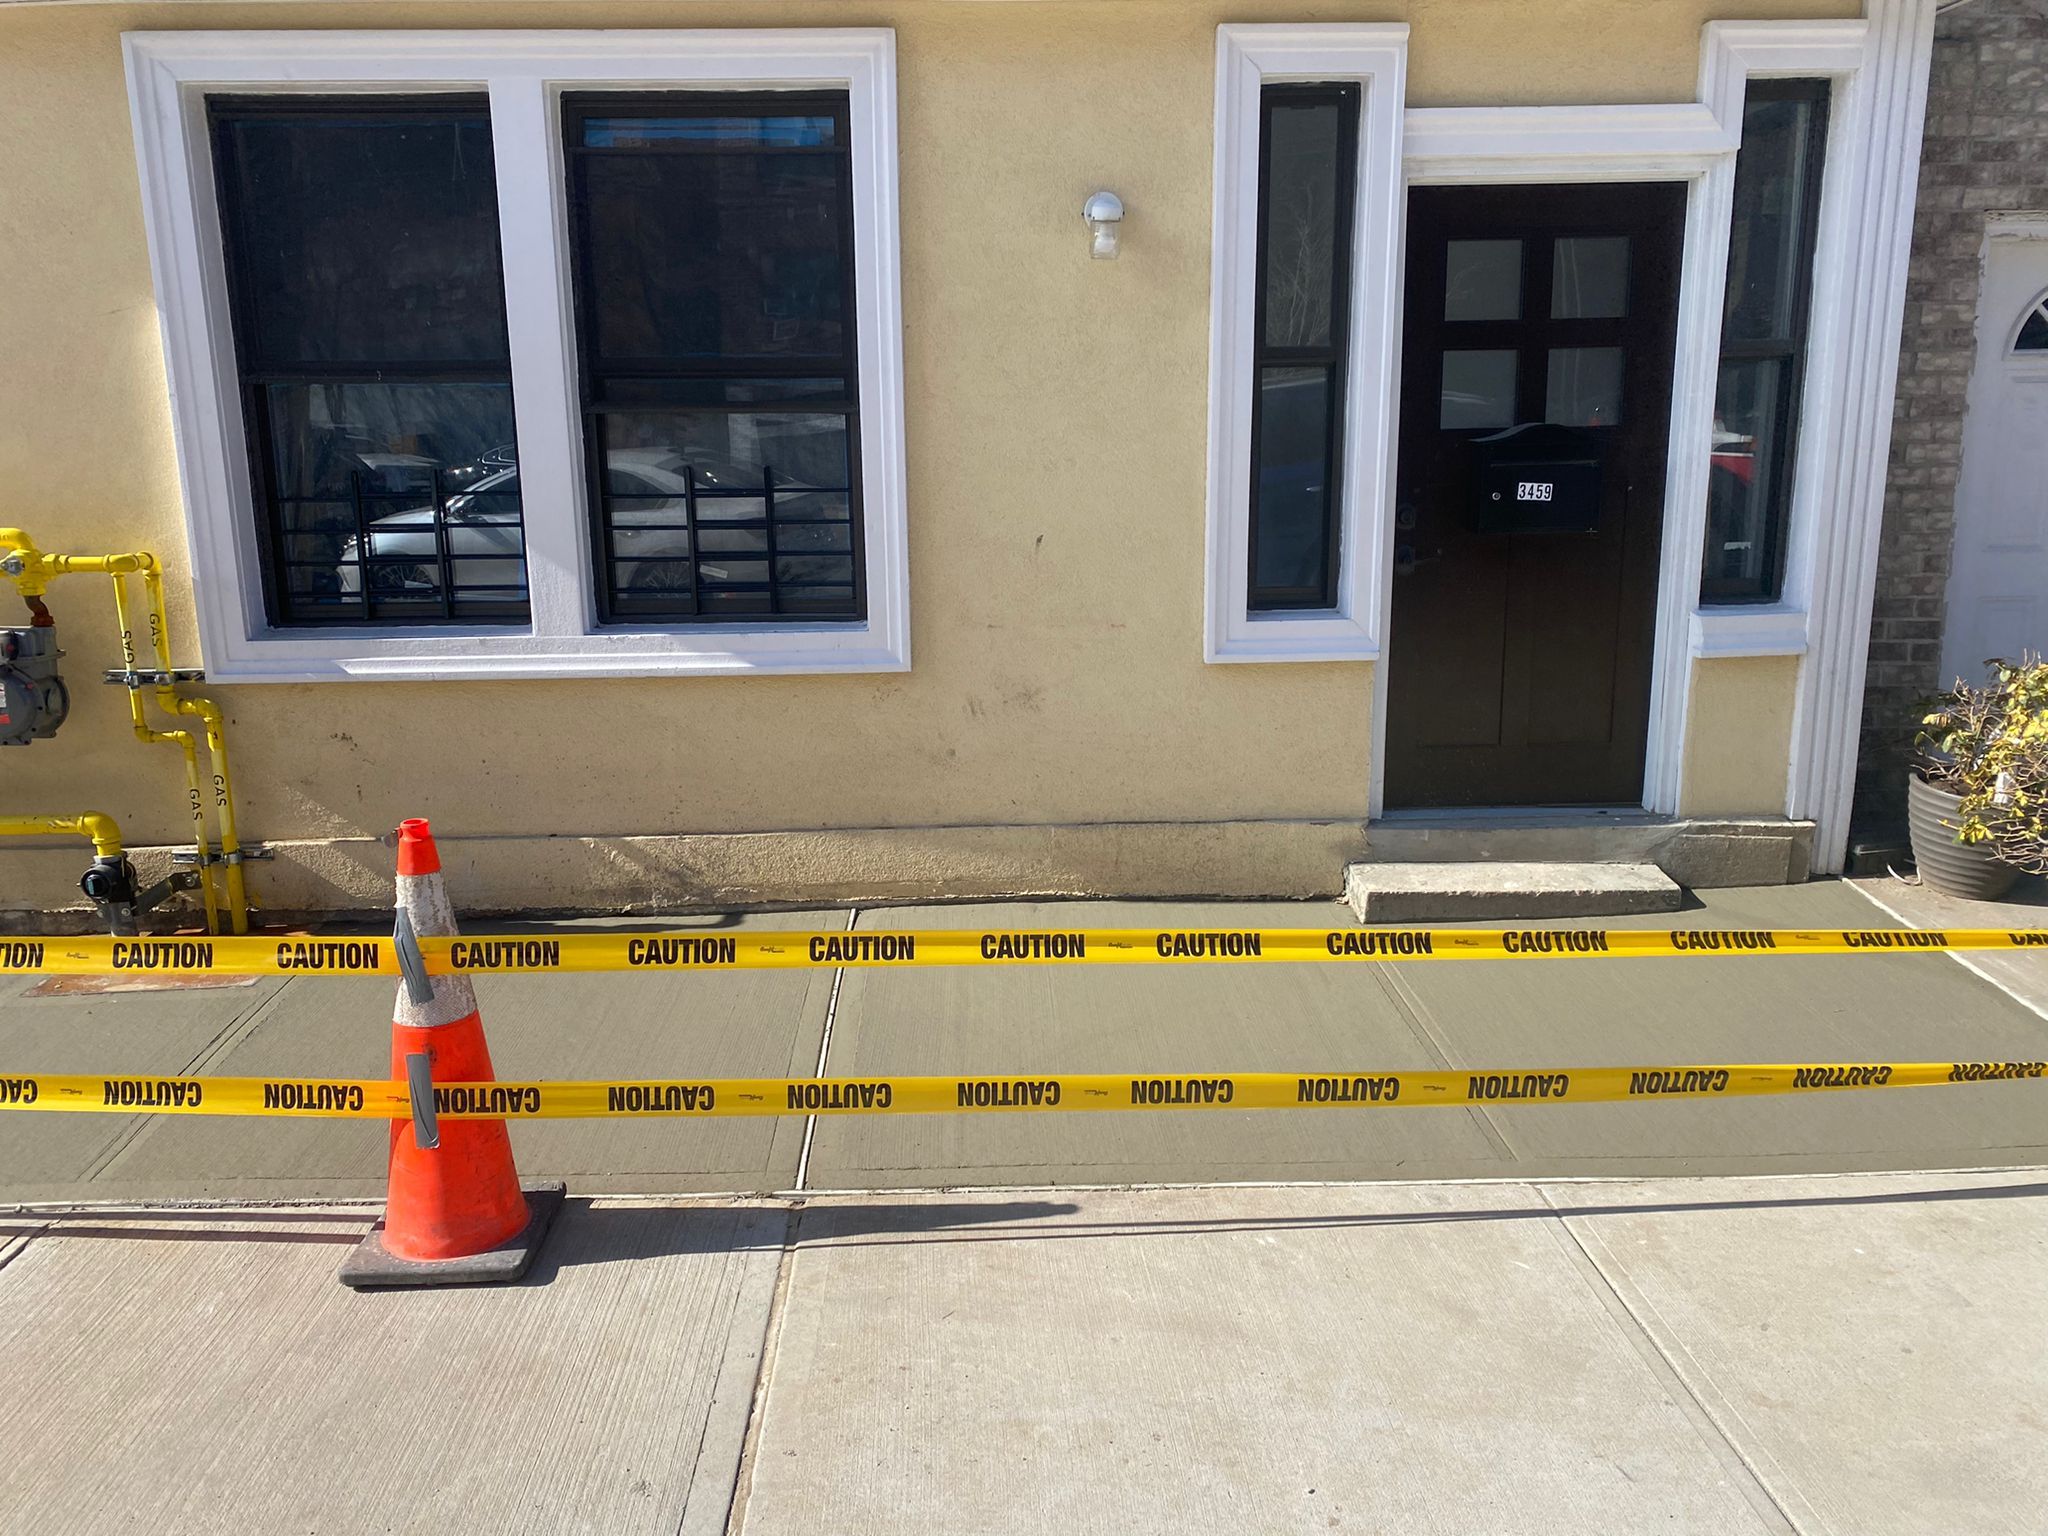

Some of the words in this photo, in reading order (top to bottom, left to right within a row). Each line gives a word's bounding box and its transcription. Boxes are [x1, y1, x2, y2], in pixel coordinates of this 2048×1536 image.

[1519, 484, 1551, 499] 3459
[150, 613, 162, 647] GAS
[122, 630, 135, 664] GAS
[213, 774, 227, 807] GAS
[190, 788, 203, 821] GAS
[113, 942, 212, 969] CAUTION
[278, 942, 378, 969] CAUTION
[451, 940, 560, 969] CAUTION
[629, 938, 735, 966] CAUTION
[810, 936, 914, 962] CAUTION
[981, 934, 1085, 960] CAUTION
[1157, 933, 1262, 957] CAUTION
[1326, 932, 1433, 956] CAUTION
[1502, 930, 1609, 953] CAUTION
[1671, 931, 1776, 950] CAUTION
[1842, 932, 1948, 947] CAUTION
[1629, 1069, 1730, 1095] CAUTION
[1792, 1066, 1893, 1089] CAUTION
[1948, 1062, 2047, 1082] CAUTION
[104, 1080, 202, 1107] CAUTION
[264, 1084, 364, 1111] CAUTION
[608, 1085, 715, 1112] CAUTION
[787, 1083, 892, 1110] CAUTION
[957, 1082, 1061, 1107] CAUTION
[1131, 1080, 1234, 1104] CAUTION
[1298, 1077, 1400, 1102] CAUTION
[1467, 1074, 1569, 1099] CAUTION
[433, 1087, 541, 1113] CAUTION
